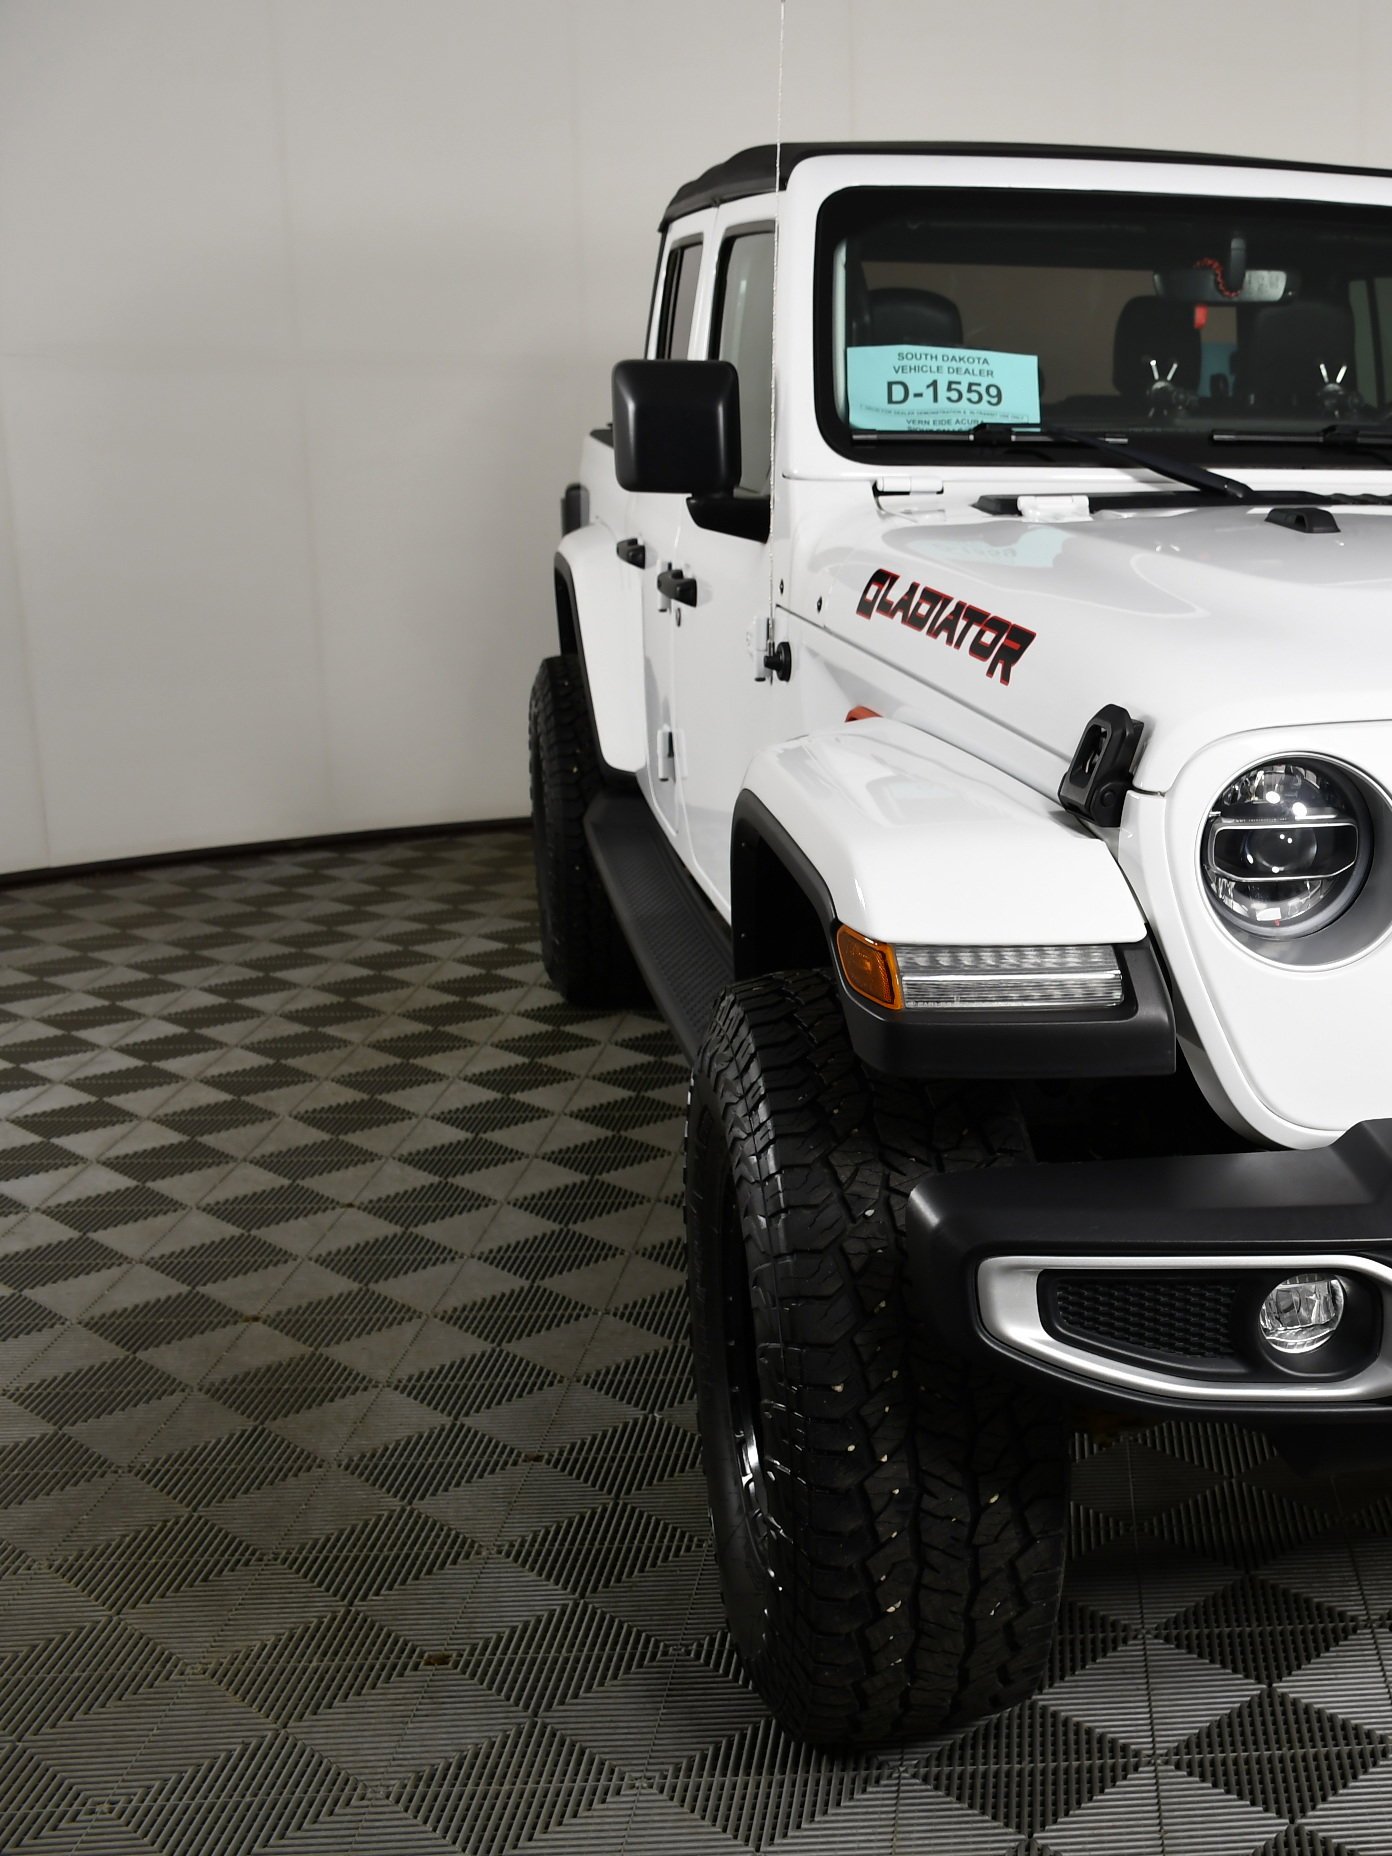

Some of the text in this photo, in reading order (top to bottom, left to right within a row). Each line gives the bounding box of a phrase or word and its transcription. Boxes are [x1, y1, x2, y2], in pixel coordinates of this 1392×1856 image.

[897, 352, 990, 365] SOUTH DAKOTA
[893, 364, 994, 378] VEHICLE DEALER
[887, 379, 1003, 406] D-1559
[906, 418, 930, 426] VERN
[932, 418, 951, 426] EIDE
[856, 568, 1037, 687] GLADIATOR
